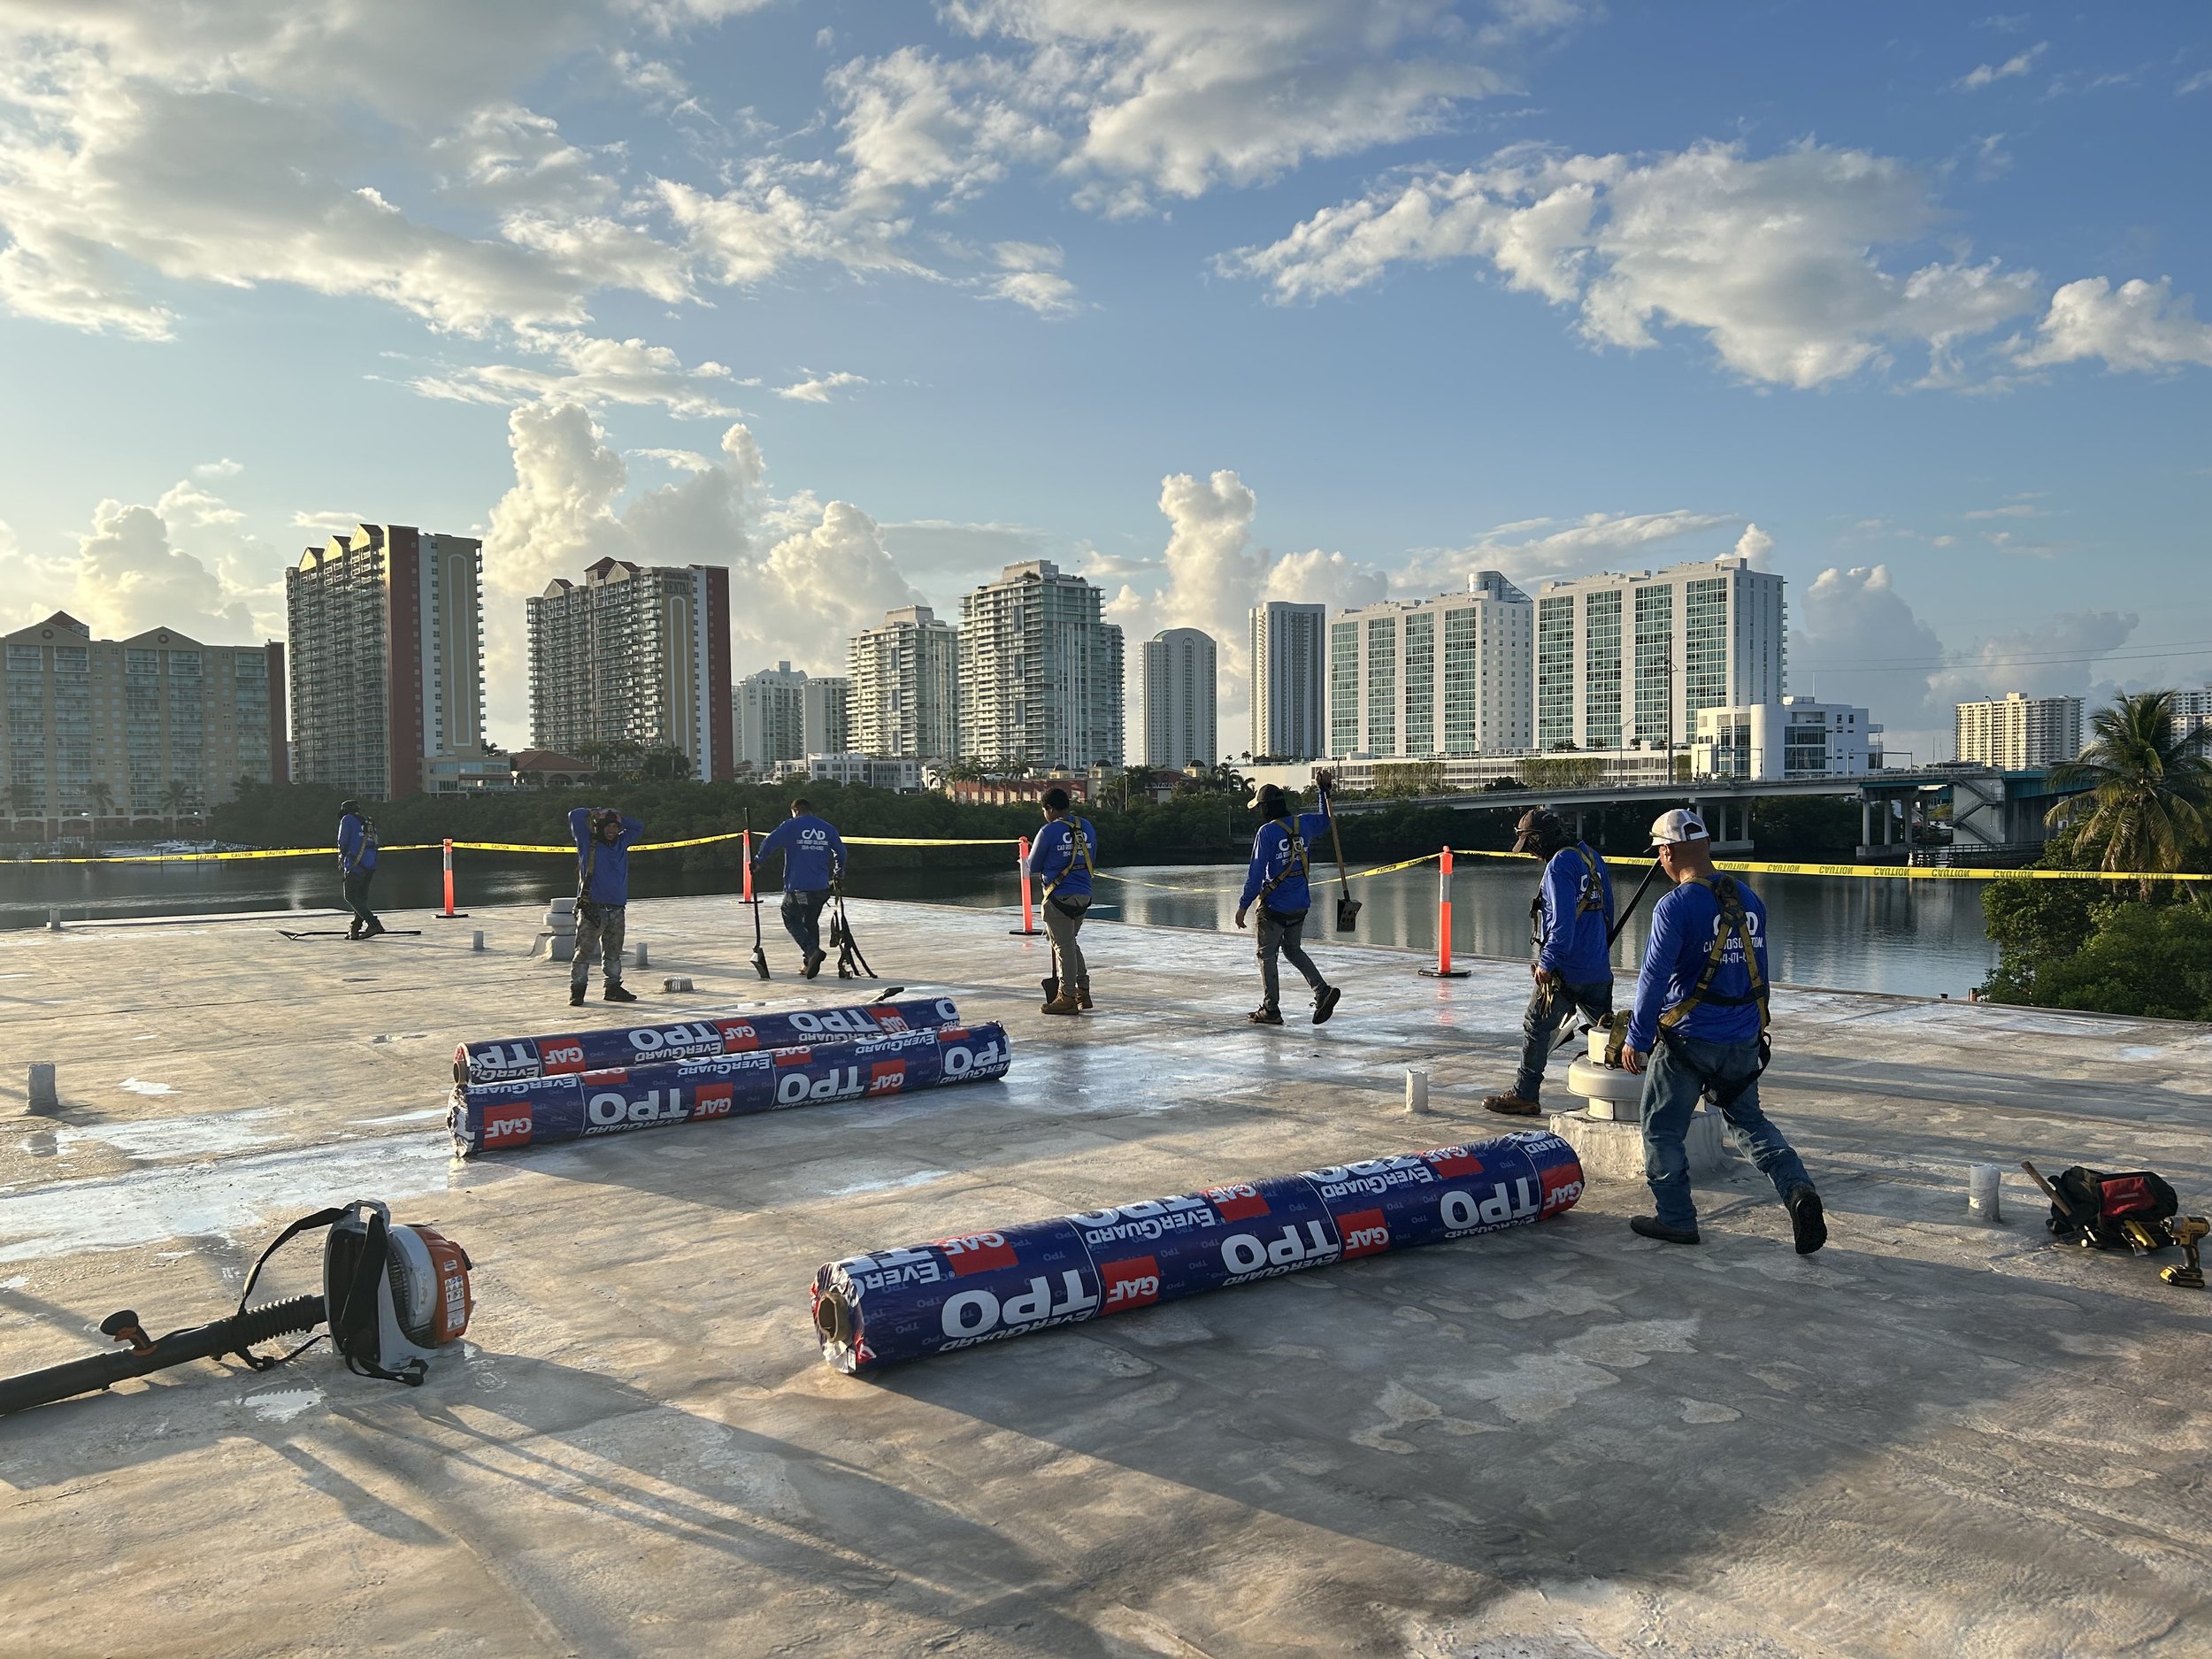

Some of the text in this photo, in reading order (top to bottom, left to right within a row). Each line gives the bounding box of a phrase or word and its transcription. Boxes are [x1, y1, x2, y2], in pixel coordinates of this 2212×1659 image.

[664, 580, 691, 595] RENTAL
[802, 827, 826, 841] CAD
[1713, 911, 1758, 936] CD
[725, 1025, 756, 1041] GAF
[787, 1009, 879, 1033] TPO
[880, 1016, 909, 1033] GAF
[628, 1023, 722, 1051] TPO
[470, 1043, 540, 1069] TP
[545, 1047, 584, 1065] GAF
[944, 1034, 1011, 1076] TPO
[778, 1065, 864, 1104] TPO
[870, 1072, 904, 1091] GAF
[940, 1063, 1010, 1085] VERGUARD
[589, 1088, 689, 1126] TPO
[694, 1097, 732, 1117] GAF
[484, 1118, 532, 1139] GAF
[1320, 1165, 1435, 1198] EVERGUARD
[1440, 1177, 1540, 1230] TPO
[1543, 1180, 1584, 1210] GAF
[1085, 1207, 1216, 1246] EVERGUARD
[1345, 1226, 1389, 1250] GAF
[944, 1233, 1005, 1256] GAF
[1220, 1219, 1340, 1275] TPO
[1106, 1275, 1160, 1303] GAF
[941, 1268, 1099, 1339] TPO
